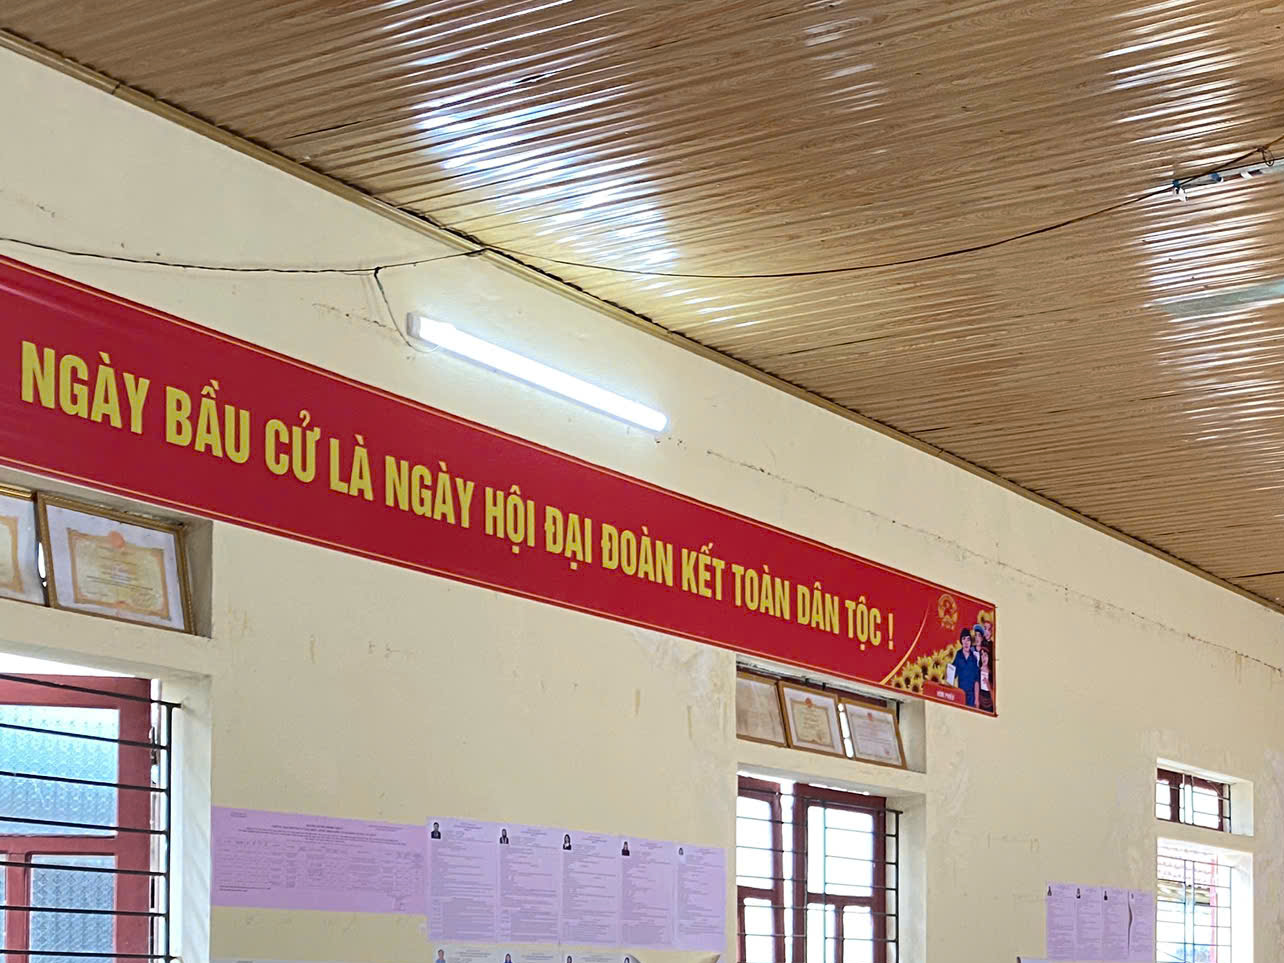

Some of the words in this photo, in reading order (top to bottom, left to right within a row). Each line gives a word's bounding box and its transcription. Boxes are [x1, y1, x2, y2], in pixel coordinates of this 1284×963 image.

[21, 340, 150, 435] NGÀY
[165, 379, 250, 464] BẦU
[265, 409, 321, 483] CỬ
[329, 434, 374, 501] LÀ
[385, 461, 475, 528] NGÀY
[484, 485, 535, 554] HỘI
[544, 505, 592, 570] ĐẠI
[601, 523, 673, 587] ĐOÀN
[681, 542, 725, 601] KẾT
[732, 564, 790, 620] TOÀN
[797, 581, 840, 635] DÂN
[845, 595, 881, 651] TỘC
